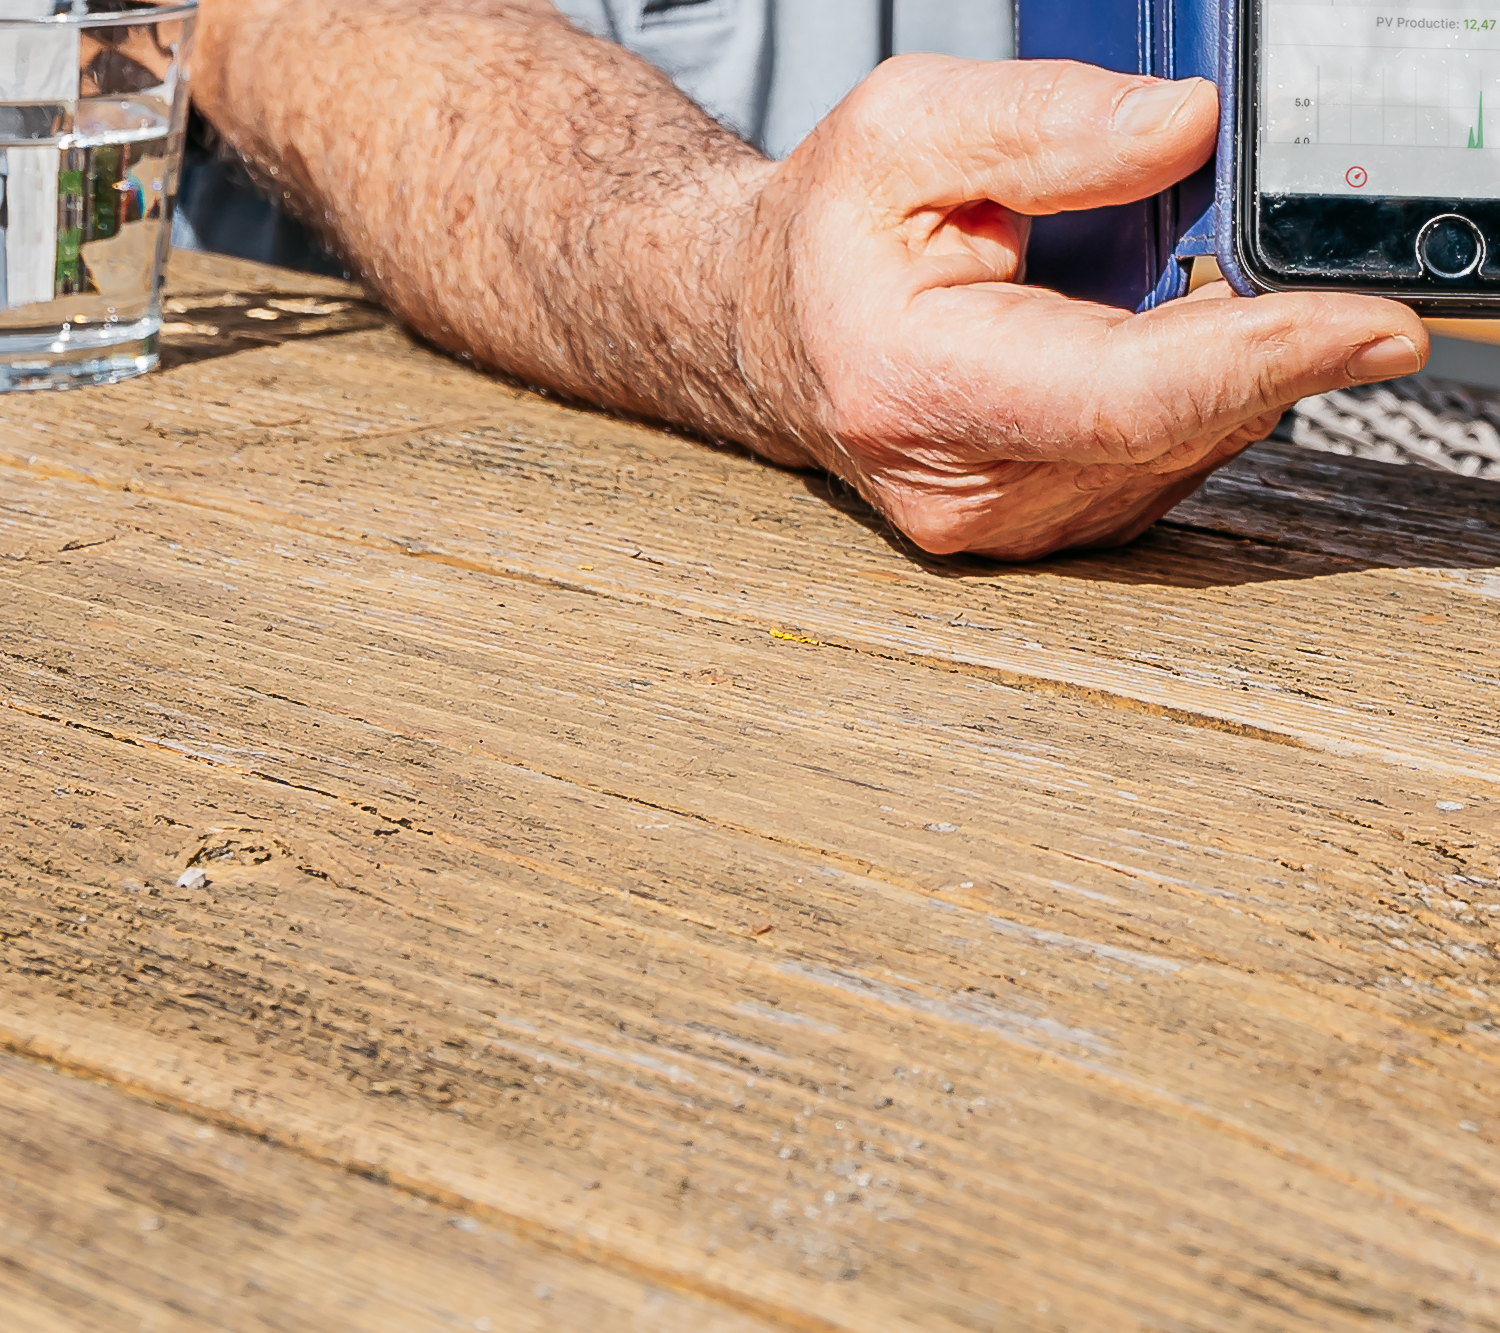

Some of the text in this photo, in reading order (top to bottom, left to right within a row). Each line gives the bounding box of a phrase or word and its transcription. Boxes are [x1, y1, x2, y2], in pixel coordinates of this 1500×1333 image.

[1376, 16, 1394, 28] PV
[1396, 17, 1460, 30] Productie:
[1463, 18, 1497, 32] 12,47
[1294, 97, 1311, 108] 5.0
